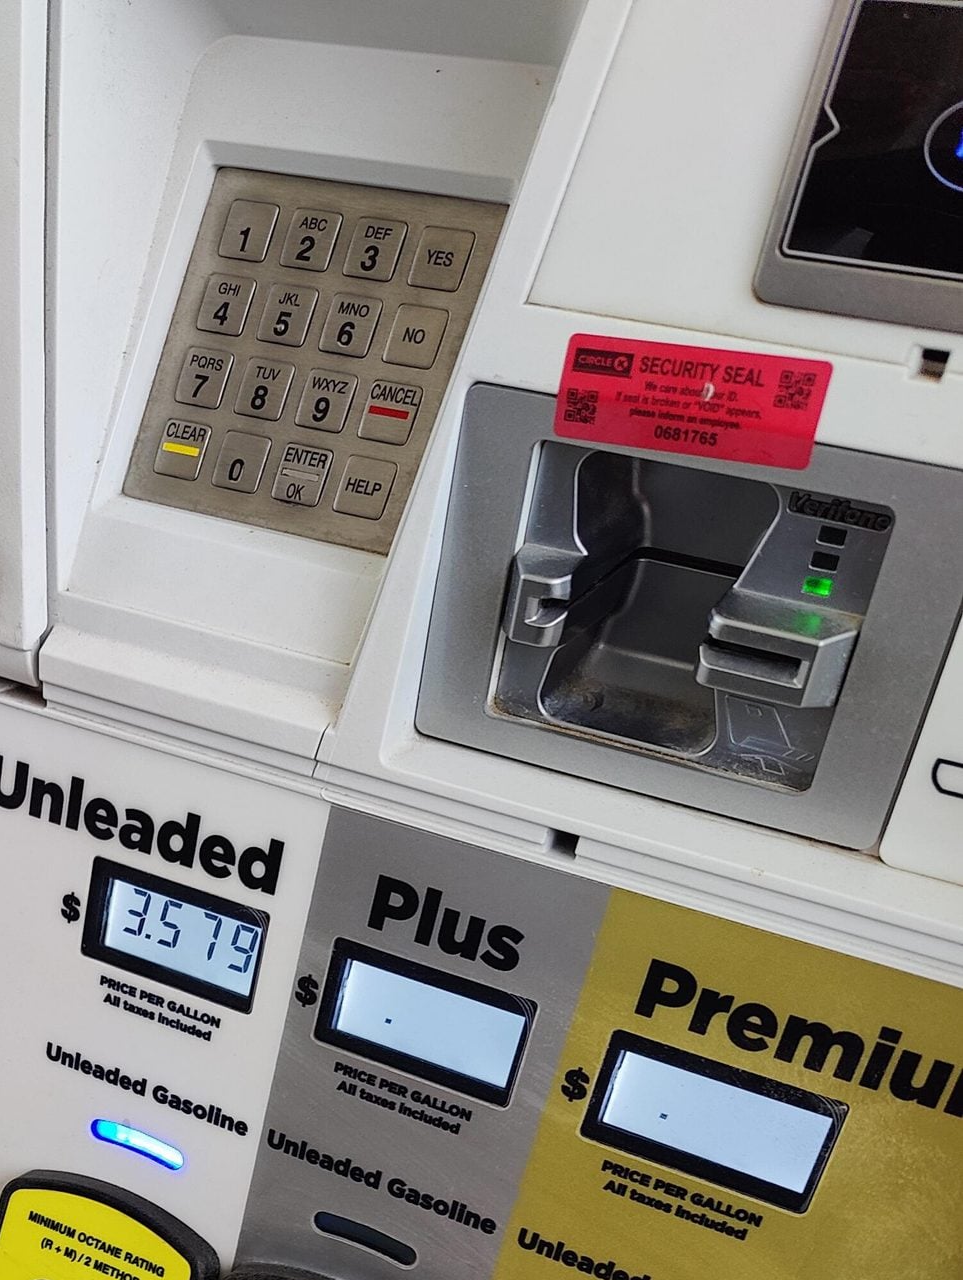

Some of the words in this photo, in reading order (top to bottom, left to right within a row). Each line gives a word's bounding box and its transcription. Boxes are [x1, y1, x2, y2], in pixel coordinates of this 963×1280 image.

[299, 217, 328, 232] ABC
[364, 226, 393, 241] DEF
[238, 226, 251, 253] 1
[295, 235, 316, 262] 2
[359, 245, 380, 272] 3
[426, 249, 455, 267] YES
[218, 282, 241, 298] GHI
[278, 292, 301, 308] JKL
[212, 301, 230, 327] 4
[338, 302, 370, 318] MNO
[272, 311, 293, 337] 5
[337, 321, 356, 347] 6
[402, 327, 426, 345] NO
[189, 354, 224, 372] PQRS
[256, 365, 281, 381] TUV
[578, 355, 613, 368] CIRCLE
[639, 355, 720, 382] SECURITY
[723, 365, 764, 387] SEAL
[192, 374, 209, 399] 7
[250, 385, 269, 411] 8
[311, 376, 349, 395] WXYZ
[370, 383, 419, 407] CANCEL
[312, 397, 330, 423] 9
[651, 396, 681, 408] broken
[629, 408, 657, 418] please
[657, 410, 685, 422] inform
[686, 415, 698, 424] an
[166, 422, 207, 442] CLEAR
[654, 425, 718, 447] 0681765
[228, 458, 245, 482] 0
[284, 447, 329, 469] ENTER
[286, 482, 304, 501] OK
[345, 478, 382, 497] HELP
[60, 891, 81, 924] $
[122, 887, 259, 974] 3.579
[367, 873, 526, 972] Plus
[99, 975, 137, 998] PRICE
[139, 990, 165, 1008] PER
[167, 1001, 221, 1029] GALLON
[294, 974, 319, 1008] $
[103, 993, 121, 1008] All
[123, 1000, 155, 1021] taxes
[634, 958, 963, 1119] Premiu
[46, 1041, 147, 1097] Unleaded
[152, 1085, 249, 1137] Gasoline
[333, 1061, 378, 1087] PRICE
[378, 1078, 409, 1099] PER
[410, 1090, 473, 1122] GALLON
[336, 1080, 358, 1097] All
[359, 1088, 397, 1112] taxes
[561, 1066, 590, 1103] $
[267, 1128, 383, 1190] Unleaded
[387, 1177, 497, 1236] Gasoline
[601, 1159, 652, 1187] PRICE
[653, 1178, 687, 1201] PER
[690, 1192, 763, 1228] GALLON
[603, 1179, 628, 1197] All
[630, 1188, 674, 1214] taxes
[28, 1210, 76, 1239] MINIMUM
[77, 1232, 123, 1259] OCTANE
[124, 1252, 165, 1278] RATING
